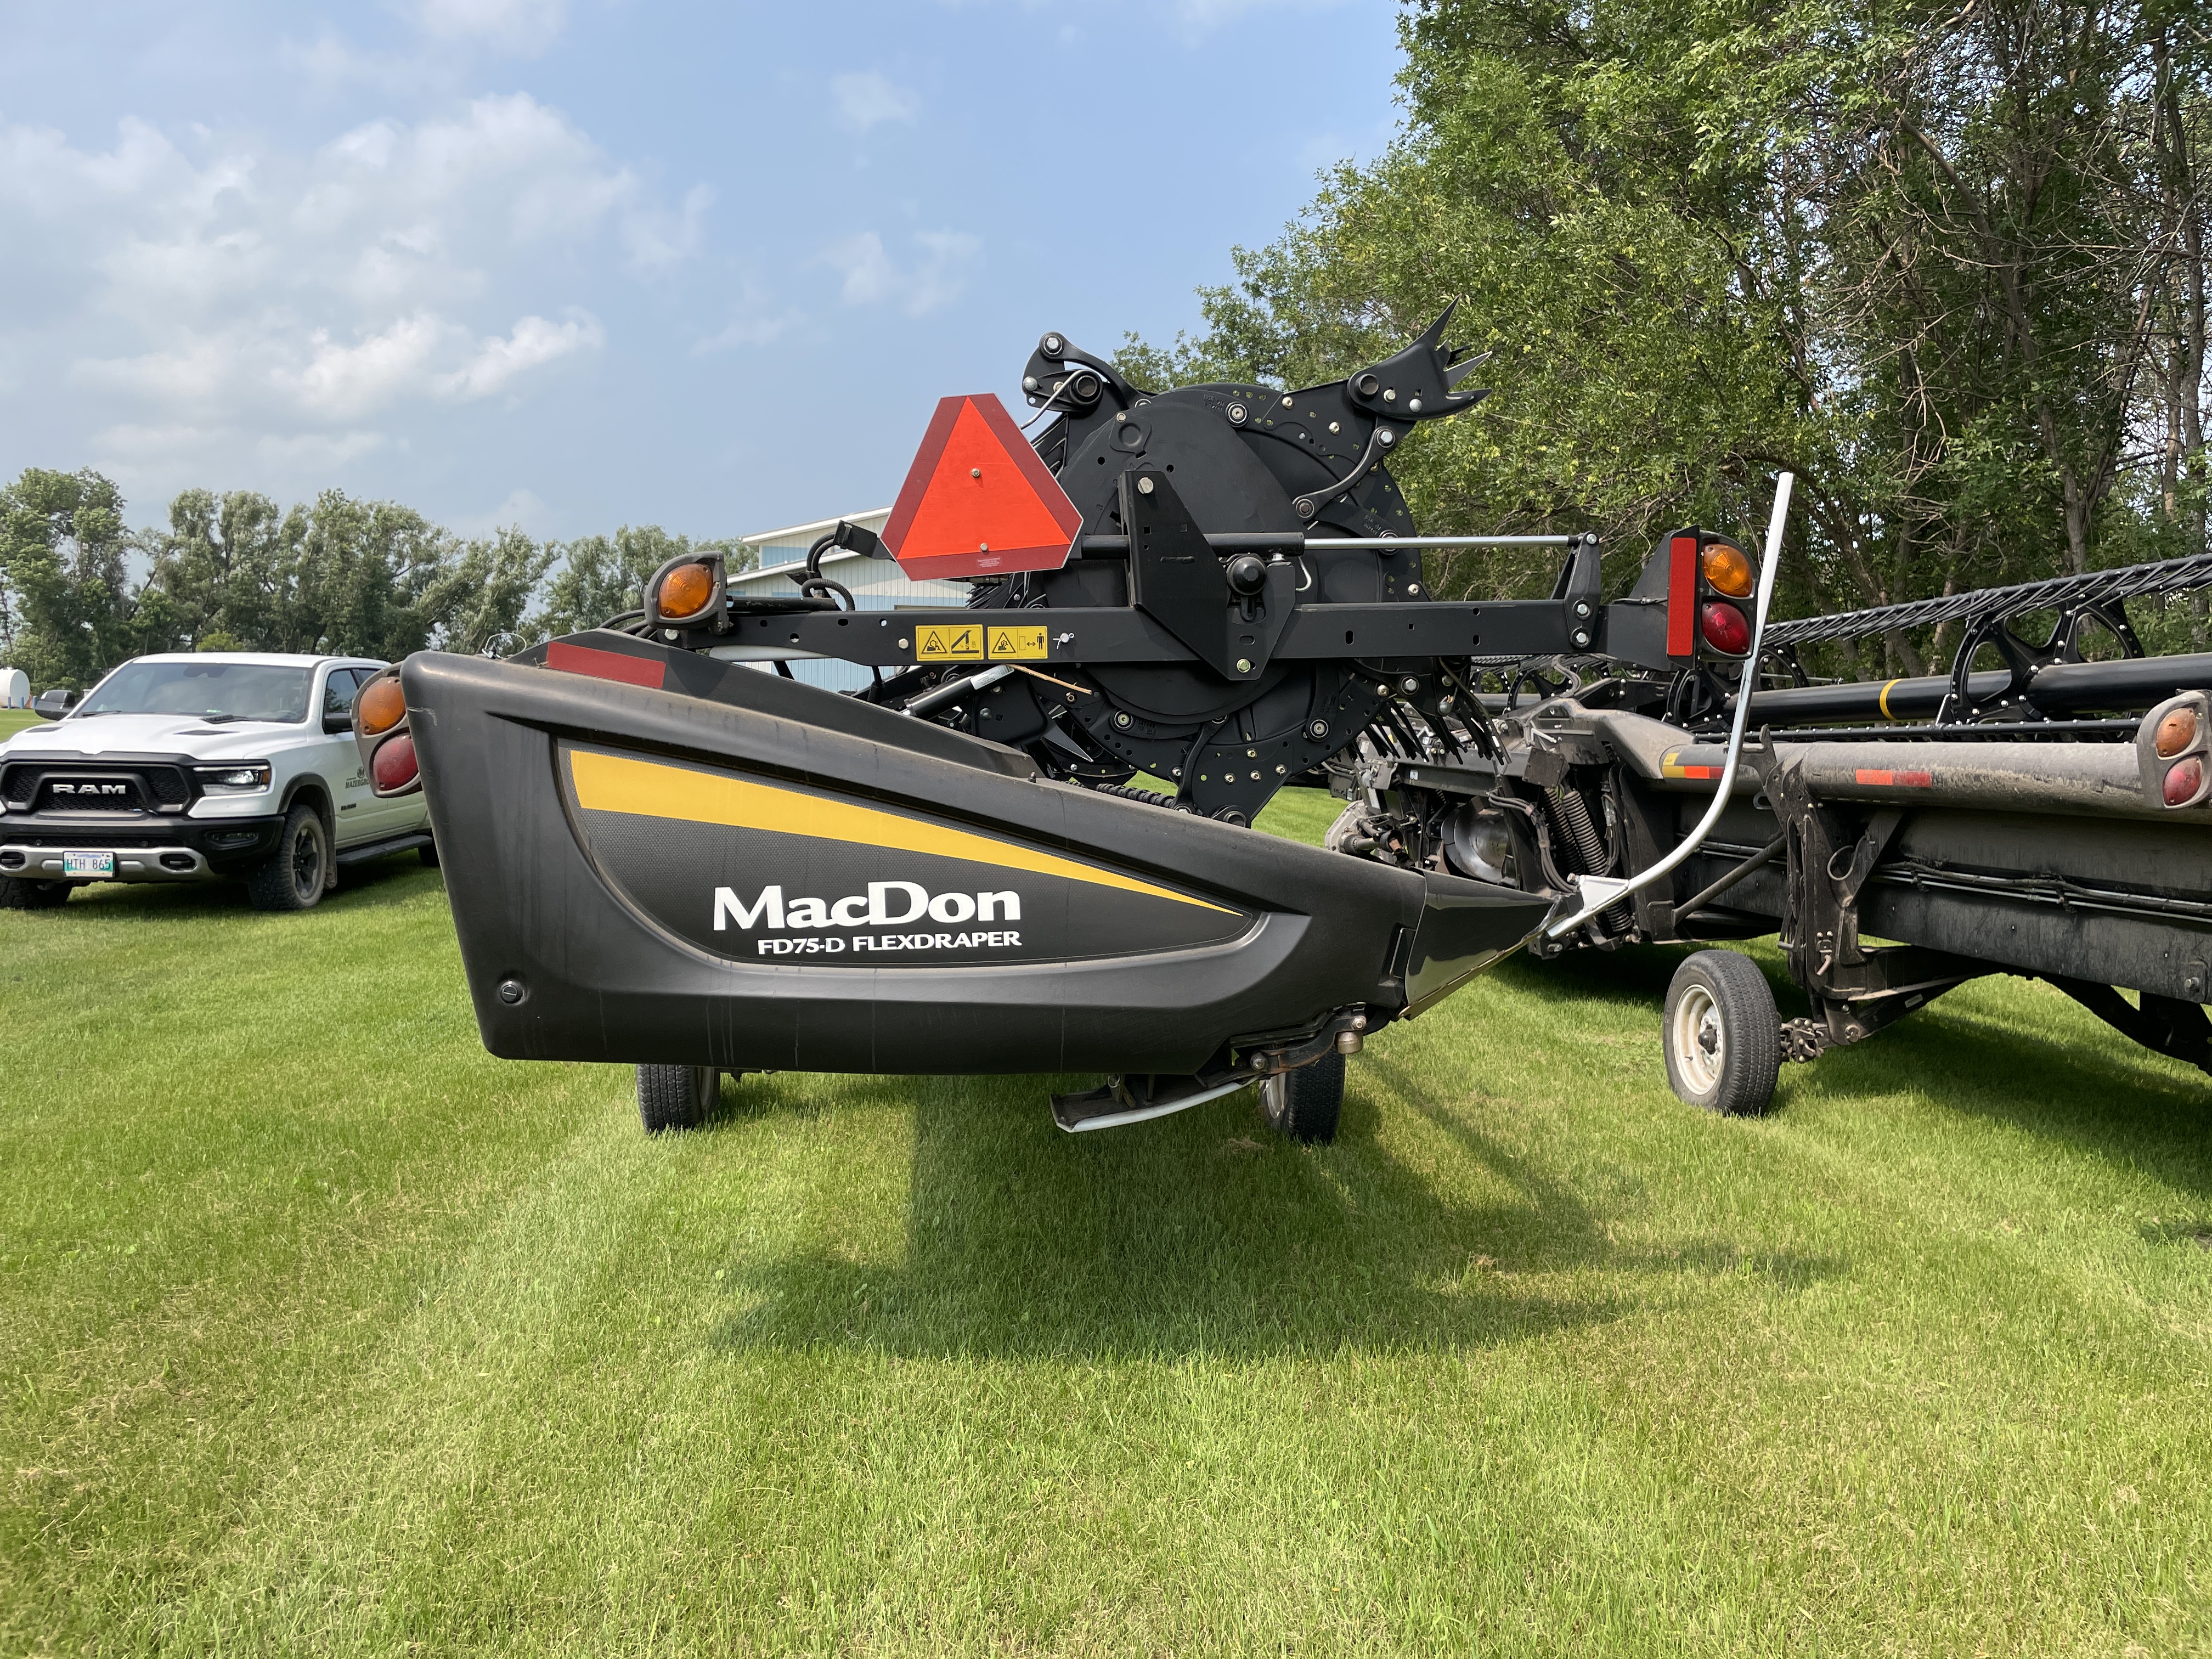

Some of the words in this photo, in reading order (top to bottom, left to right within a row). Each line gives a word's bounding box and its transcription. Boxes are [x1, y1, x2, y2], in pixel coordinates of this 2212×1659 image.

[53, 784, 126, 794] RAM
[67, 859, 86, 870] HTH
[92, 859, 111, 870] 865
[713, 881, 1022, 931] MacDon
[758, 938, 846, 955] FD75-D
[853, 931, 1023, 952] FLEXDRAPER
